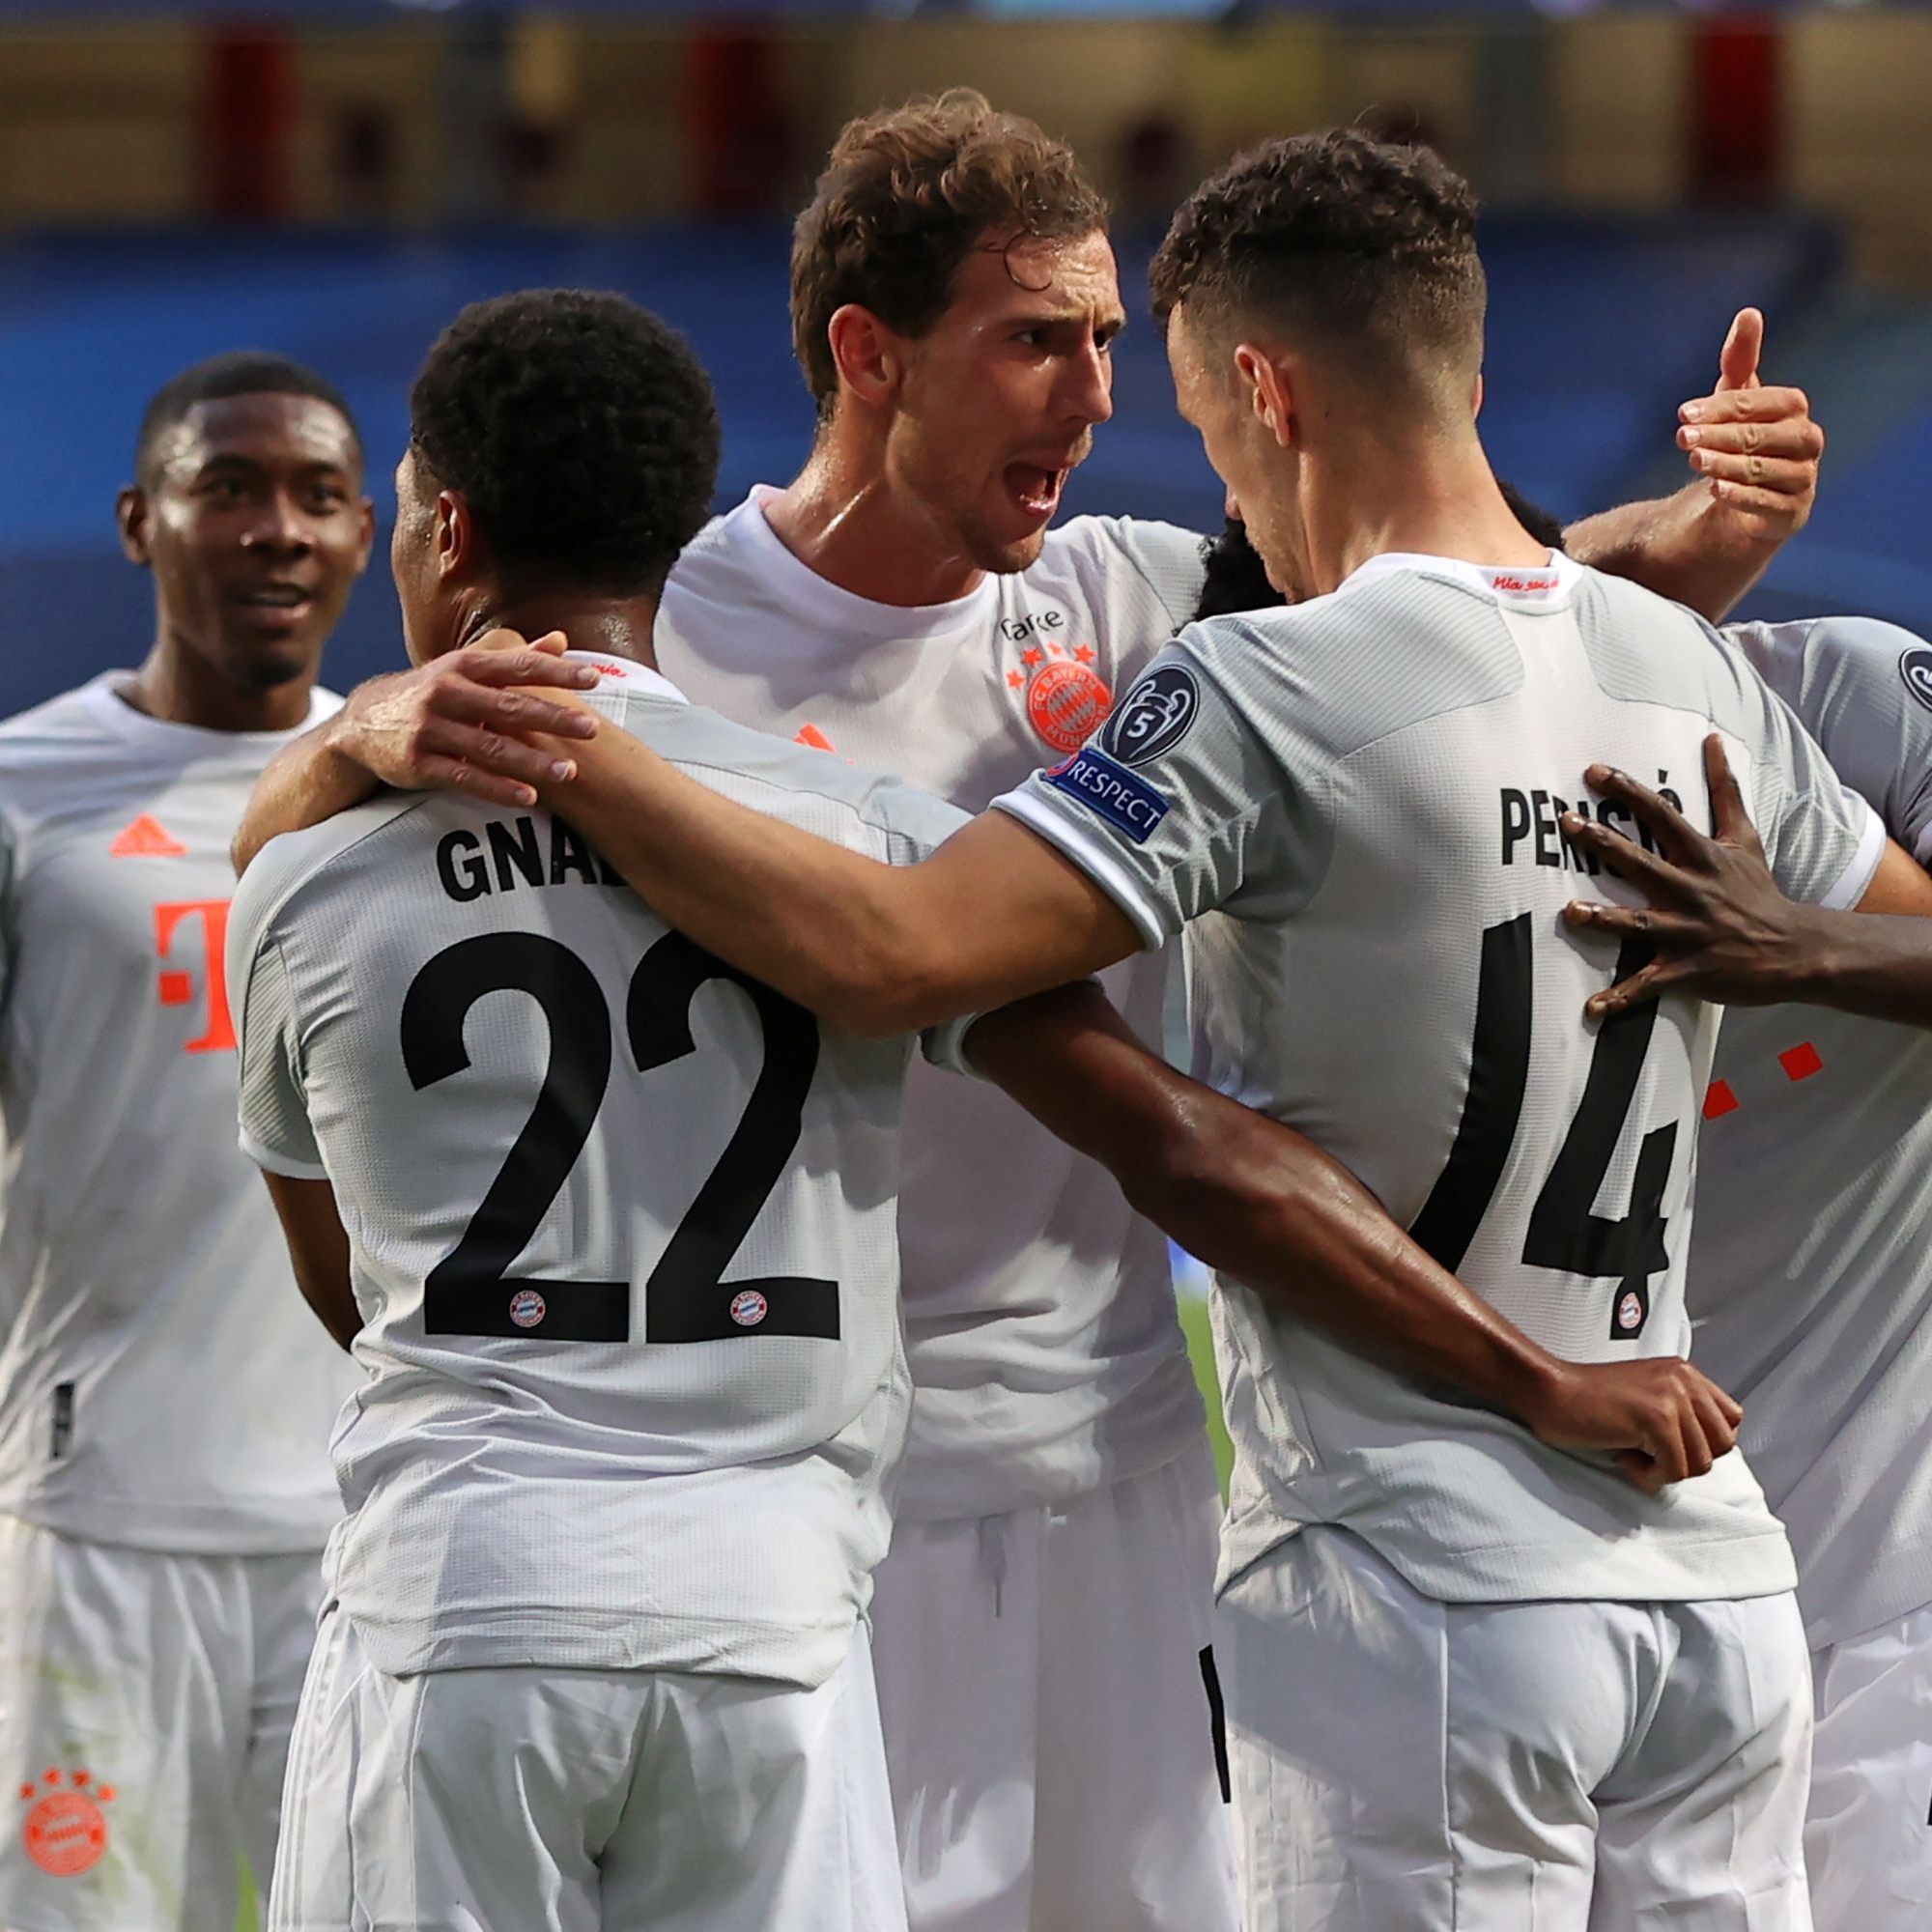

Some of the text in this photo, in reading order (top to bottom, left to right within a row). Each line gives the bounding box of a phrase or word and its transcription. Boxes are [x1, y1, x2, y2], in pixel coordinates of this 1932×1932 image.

[1126, 711, 1156, 738] 5
[1067, 760, 1161, 829] RESPECT
[437, 816, 628, 902] GNA
[400, 928, 841, 1345] 22
[1407, 911, 1679, 1341] 14
